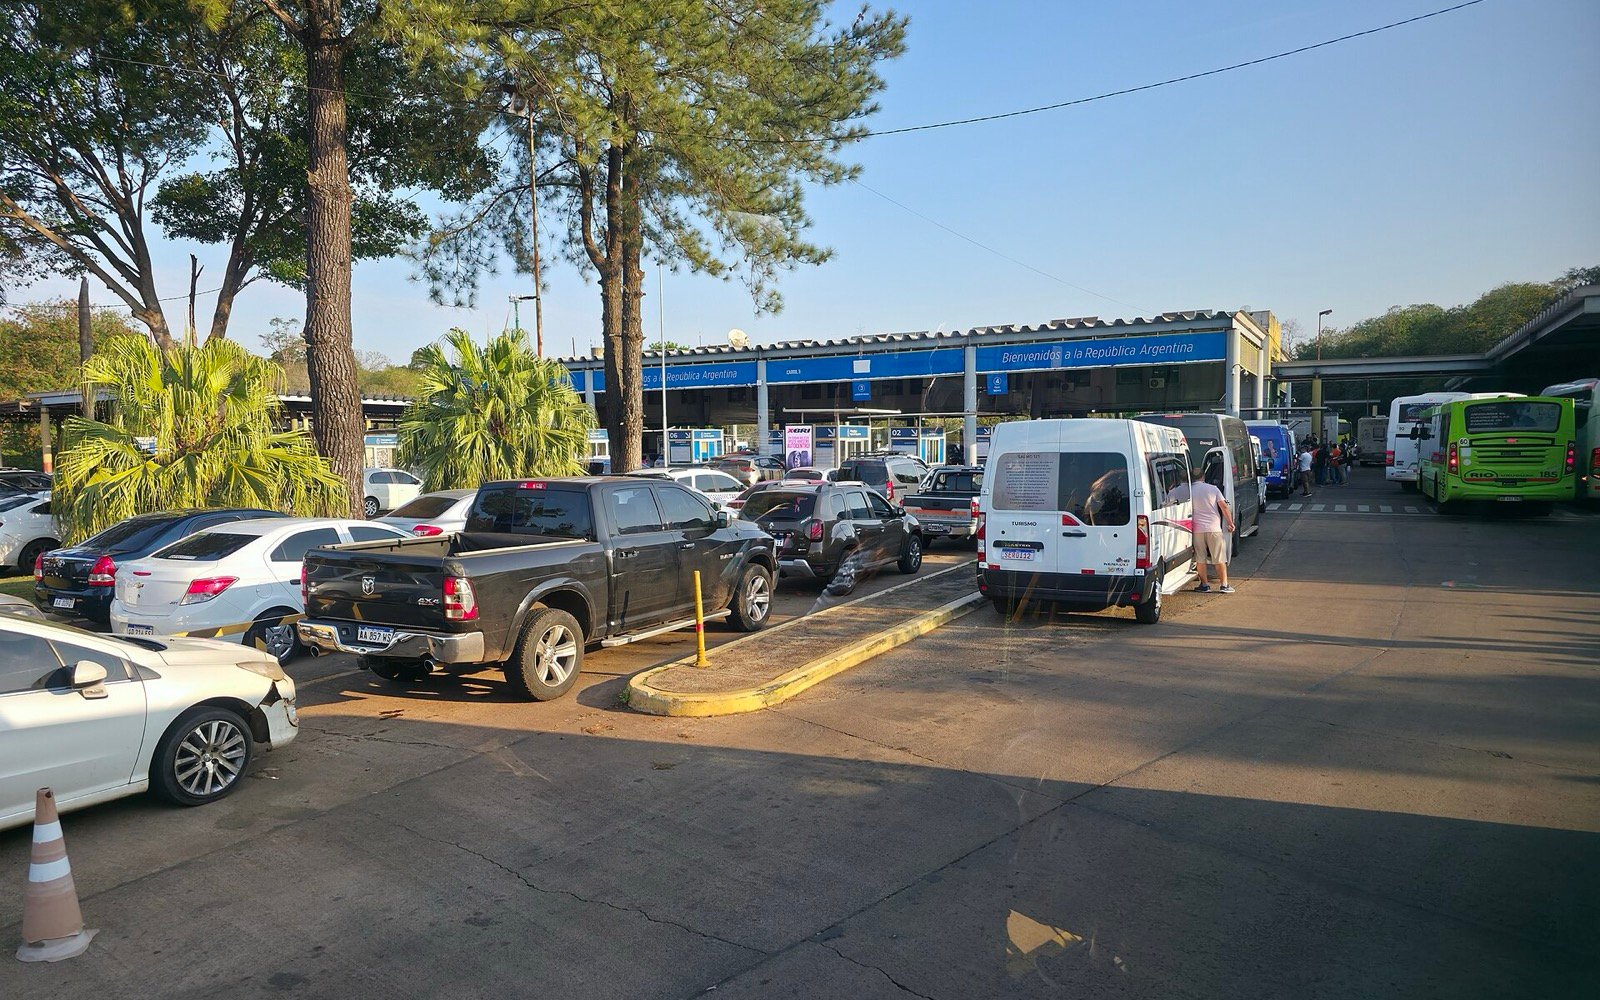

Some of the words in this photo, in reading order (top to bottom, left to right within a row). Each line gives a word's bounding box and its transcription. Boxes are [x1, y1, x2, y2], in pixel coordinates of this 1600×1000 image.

[1002, 350, 1061, 363] Bienvenidos
[1064, 351, 1071, 359] a
[1073, 348, 1083, 359] la
[1084, 345, 1136, 360] República
[1139, 342, 1194, 357] Argentina
[652, 375, 658, 383] a
[666, 370, 700, 383] República
[701, 369, 738, 381] Argentina
[359, 630, 368, 640] AA
[369, 631, 381, 641] 857
[382, 632, 391, 643] WS
